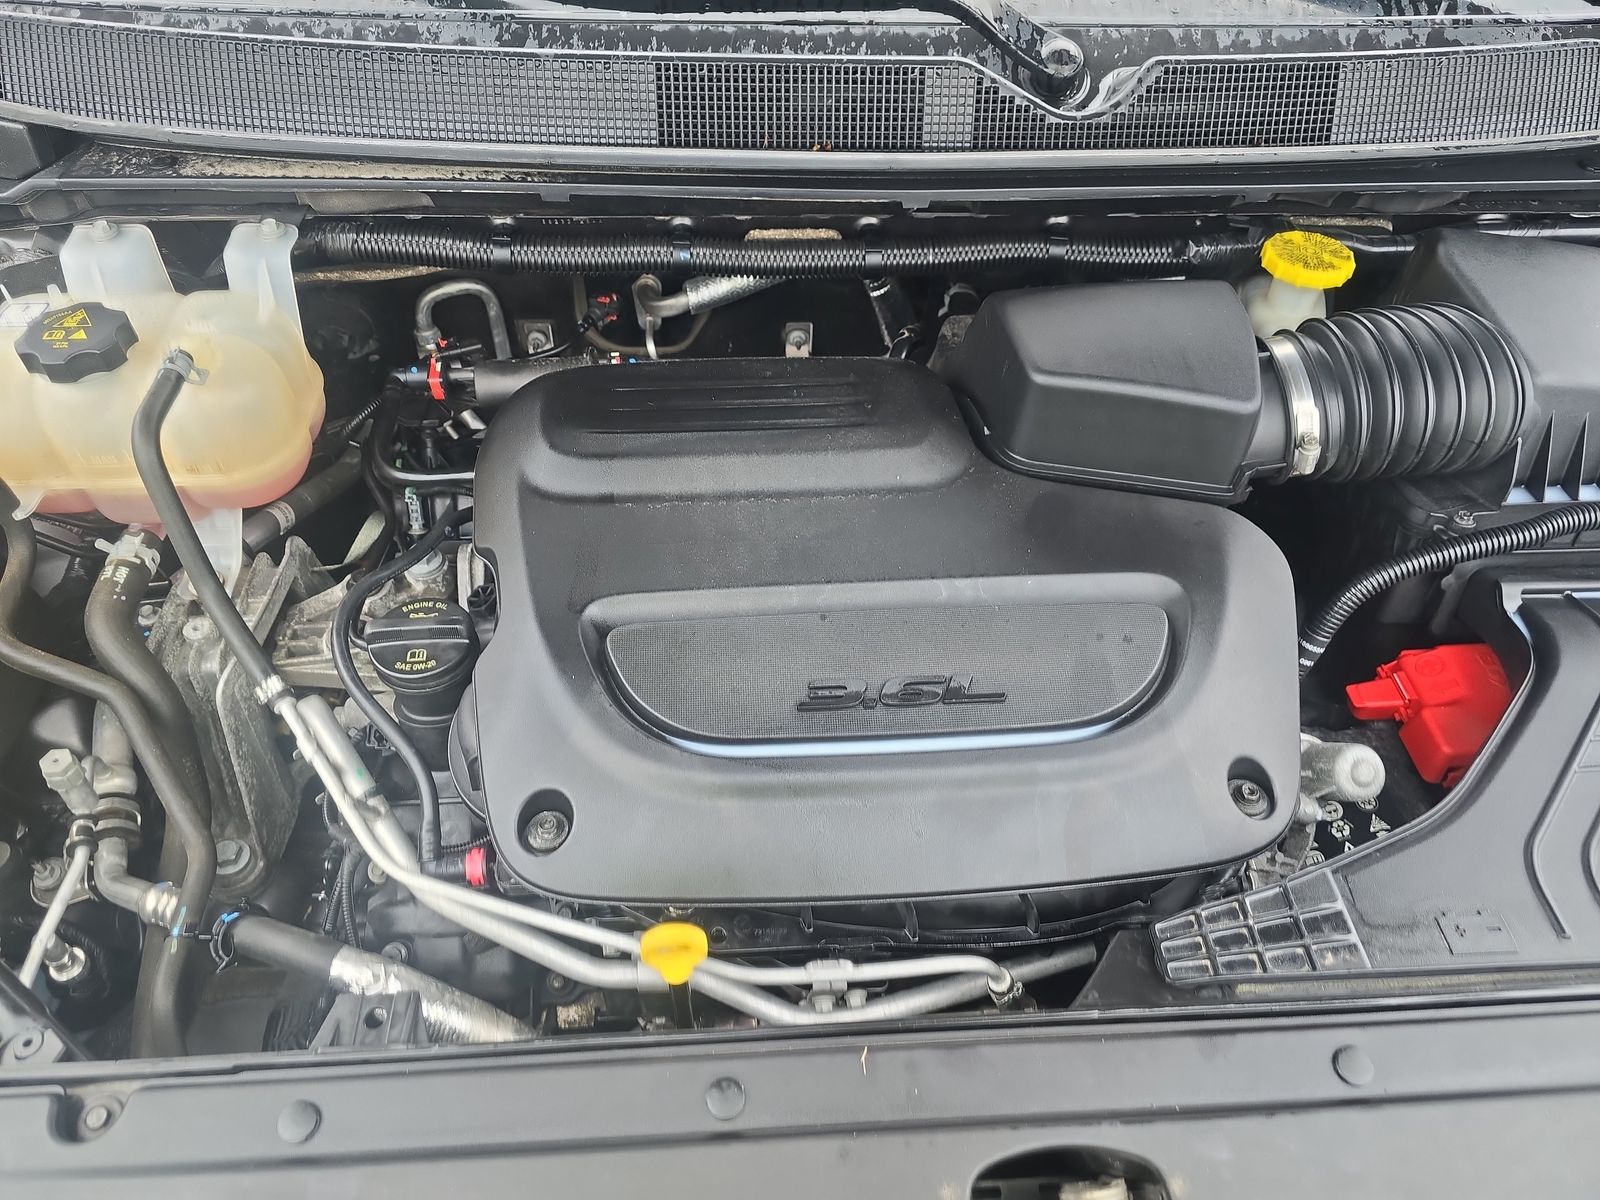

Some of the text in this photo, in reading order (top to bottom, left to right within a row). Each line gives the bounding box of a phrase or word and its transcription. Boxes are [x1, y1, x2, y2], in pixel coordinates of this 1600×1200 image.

[402, 601, 448, 612] ENGINE OIL
[395, 660, 437, 671] SAE 0W-20
[797, 674, 1007, 711] 3.6L
